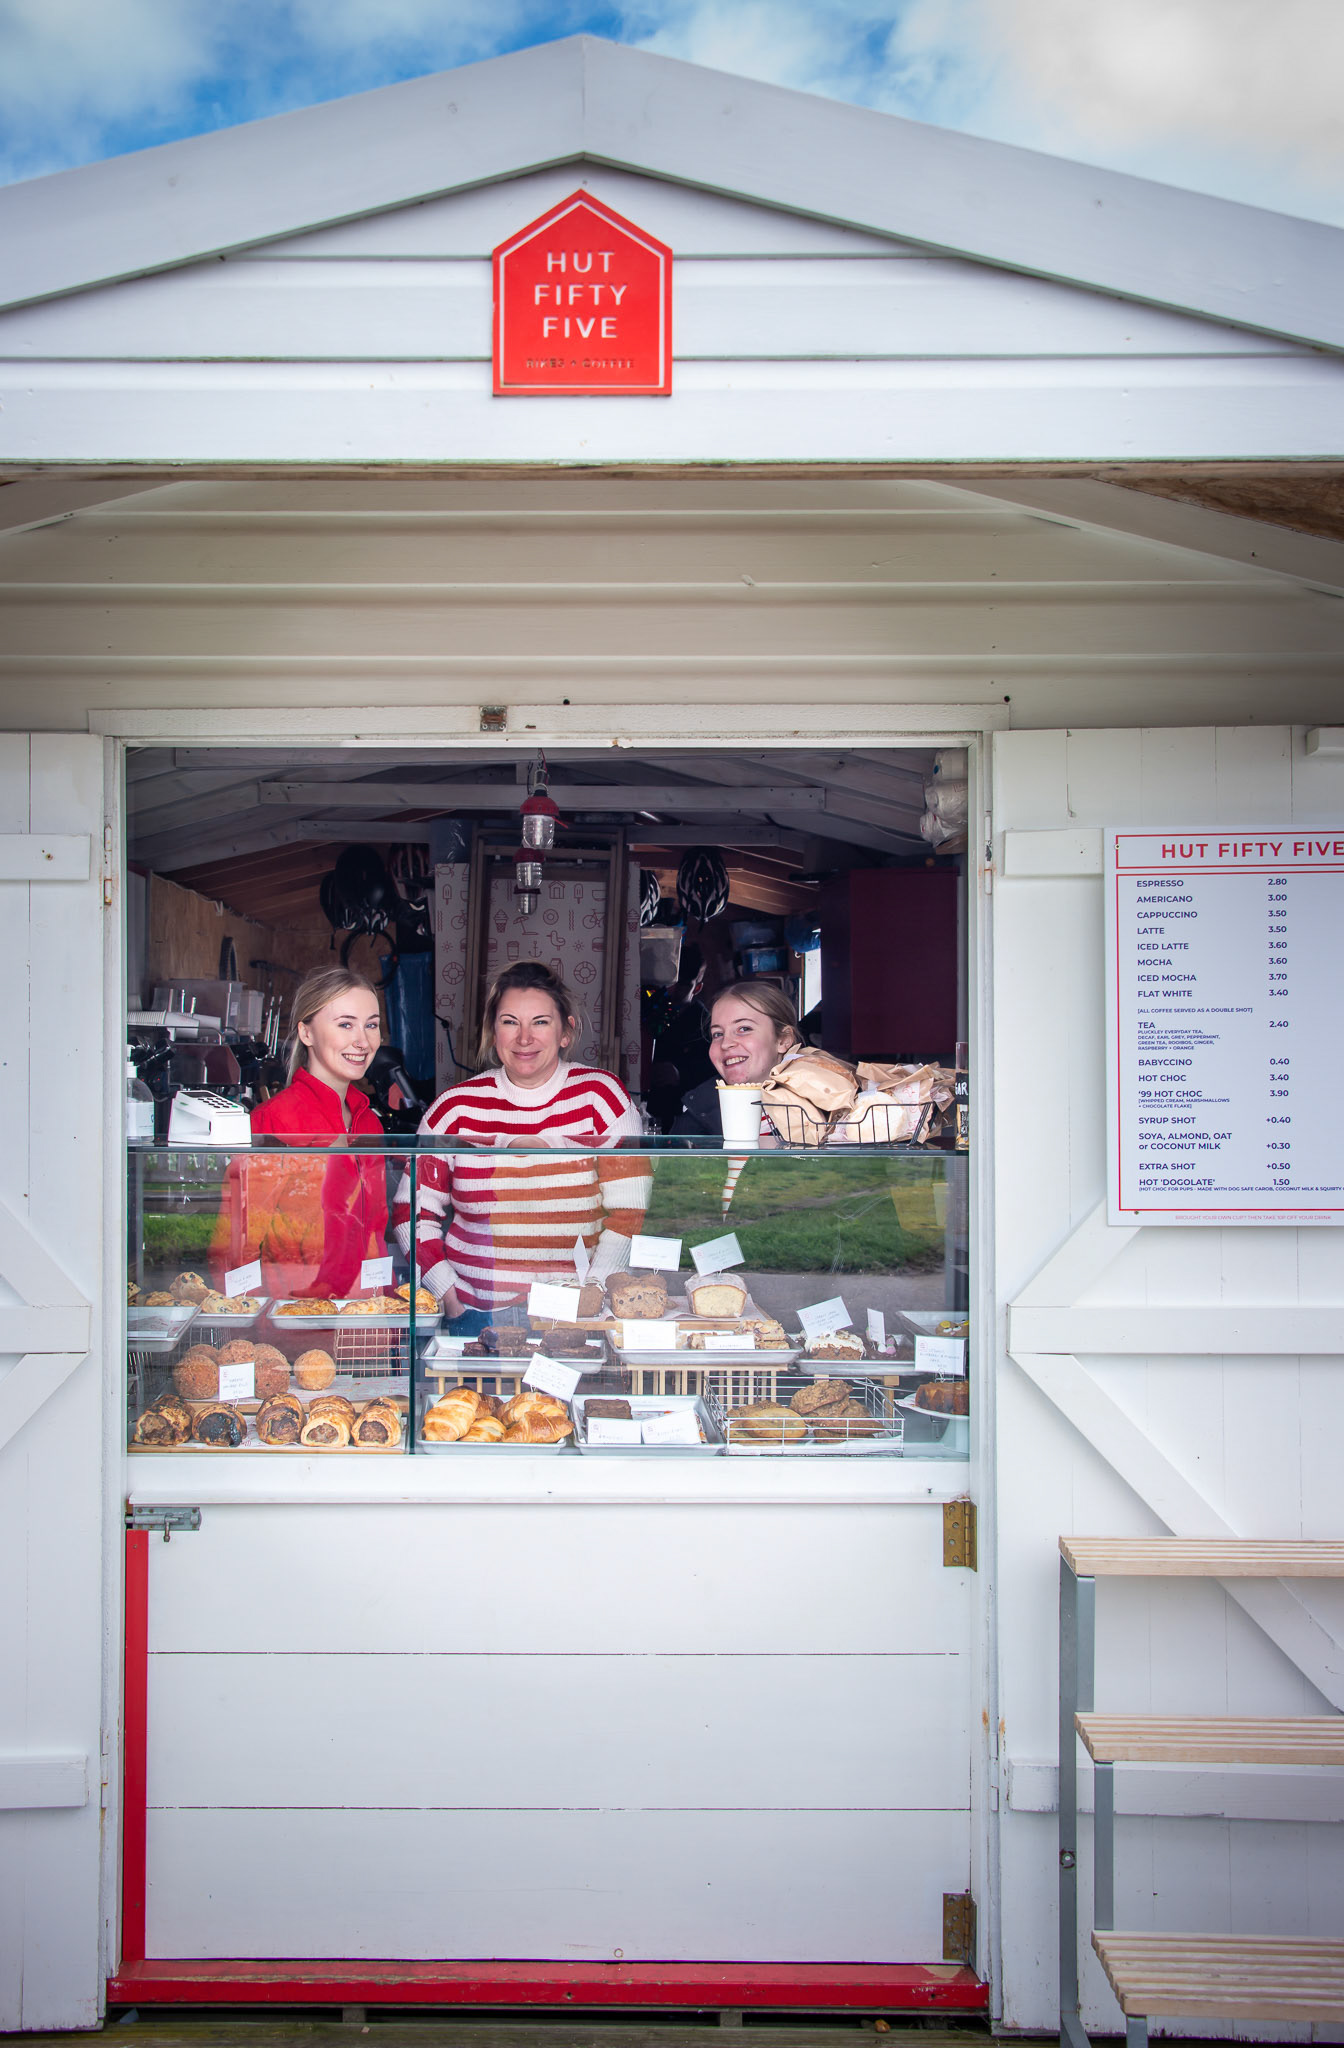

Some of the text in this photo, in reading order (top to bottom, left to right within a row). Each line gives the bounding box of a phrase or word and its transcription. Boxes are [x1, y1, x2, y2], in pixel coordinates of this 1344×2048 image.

[547, 252, 615, 273] HUT
[534, 284, 627, 305] FIFTY
[543, 317, 618, 338] FIVE
[582, 358, 634, 368] COFFEE
[1162, 841, 1344, 858] HUT FIFTY FIVE
[1136, 895, 1193, 903] AMERICANO
[1137, 911, 1198, 919] CAPPUCCINO
[1137, 927, 1165, 935] LATTE
[1268, 941, 1288, 949] 3.60
[1137, 974, 1197, 982] ICED MOCHA
[1268, 973, 1288, 981] 3.70
[1138, 990, 1160, 998] FLAT
[1154, 1090, 1173, 1098] HOT
[1139, 1133, 1166, 1141] SOYA,
